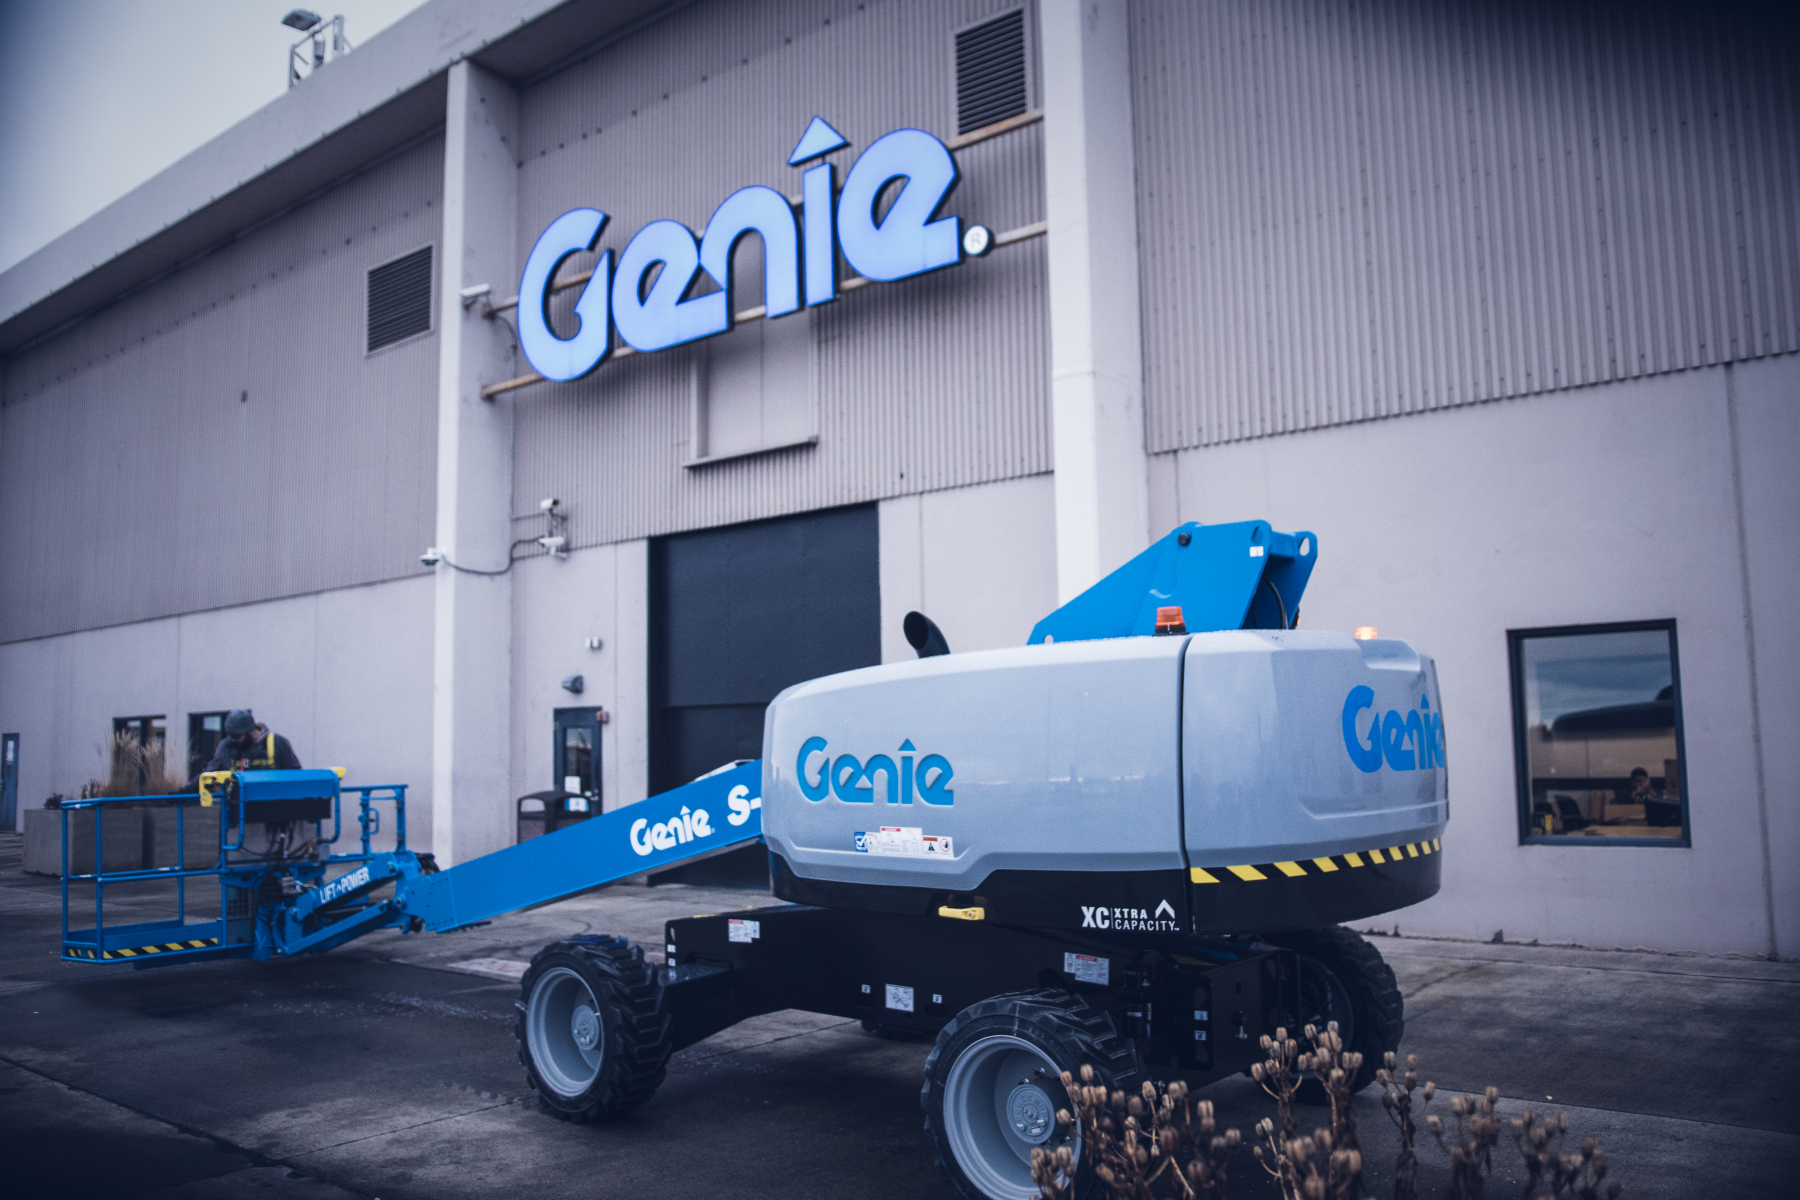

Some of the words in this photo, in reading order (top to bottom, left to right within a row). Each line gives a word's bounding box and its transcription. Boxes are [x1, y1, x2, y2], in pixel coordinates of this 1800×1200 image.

[1342, 685, 1445, 773] Genie
[797, 736, 954, 806] Genie
[629, 805, 712, 856] Genie
[320, 882, 337, 904] LIFT
[341, 866, 370, 893] POWER
[1081, 906, 1110, 929] XC
[1113, 908, 1148, 919] XTRA
[1115, 920, 1176, 931] CAPACITY
